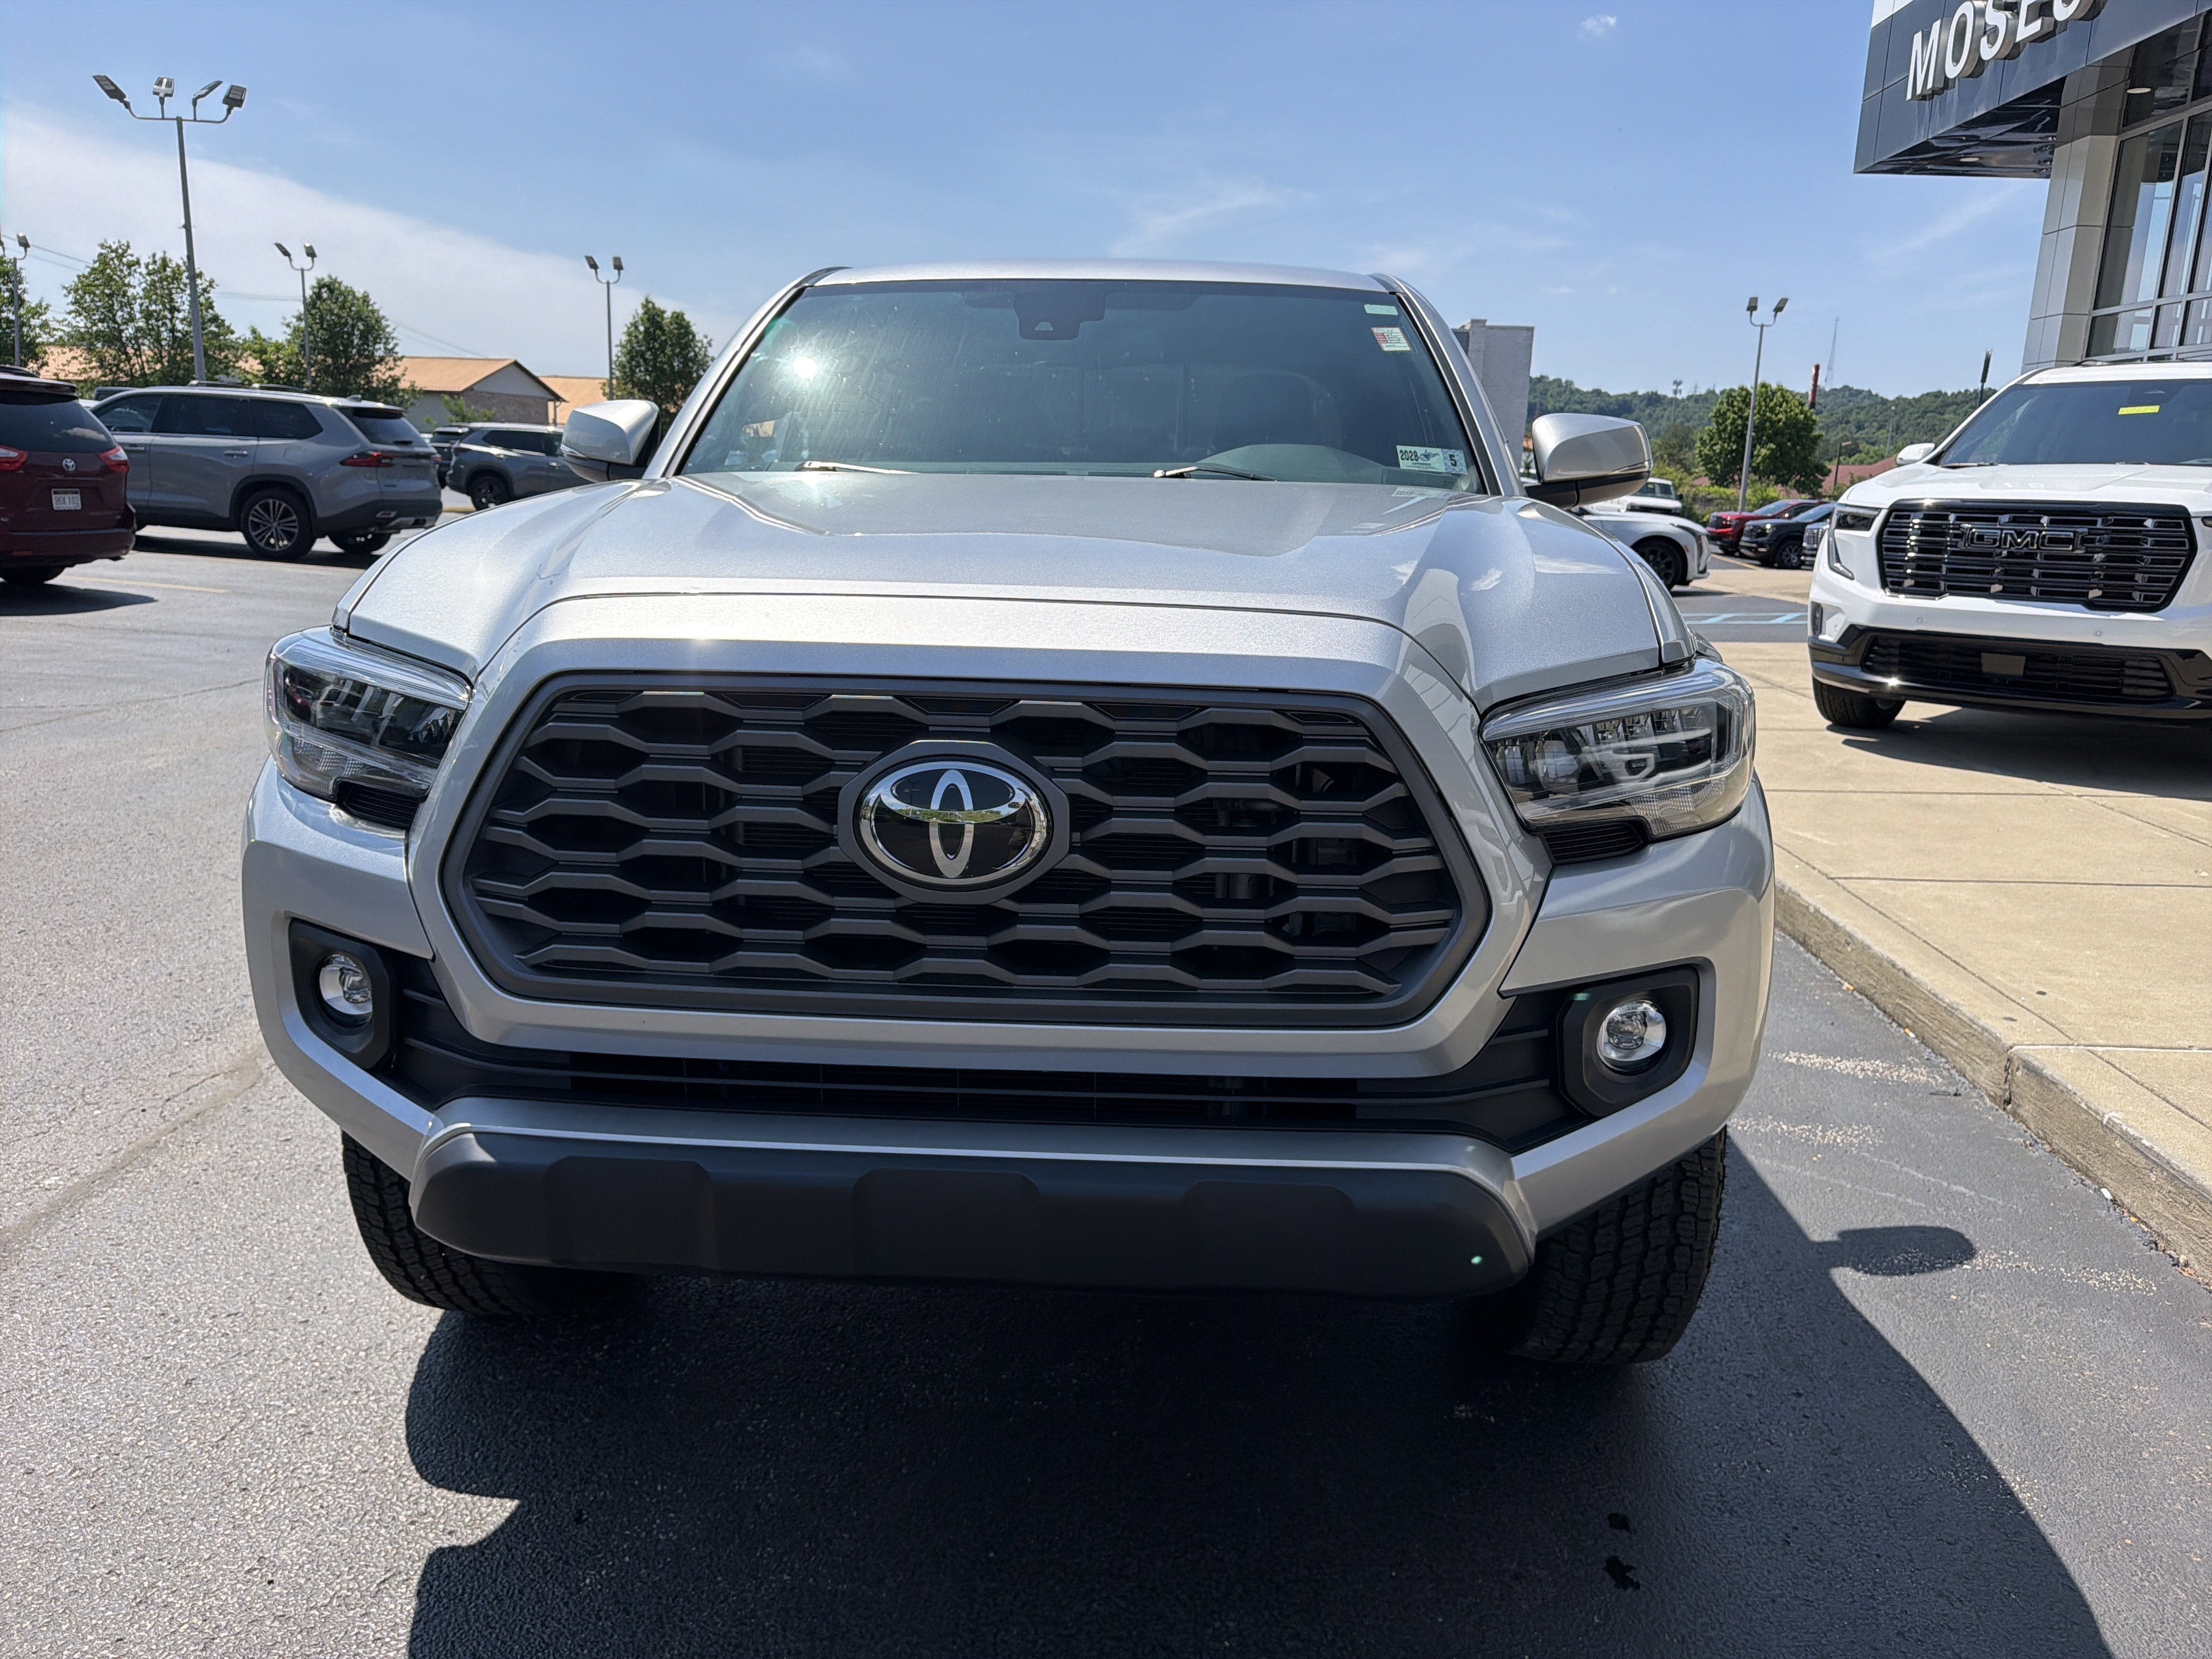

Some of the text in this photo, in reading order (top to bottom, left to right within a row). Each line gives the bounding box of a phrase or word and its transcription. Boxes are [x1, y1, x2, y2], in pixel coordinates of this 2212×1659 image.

[1400, 450, 1457, 467] 2028 5
[1967, 528, 2074, 550] GMC
